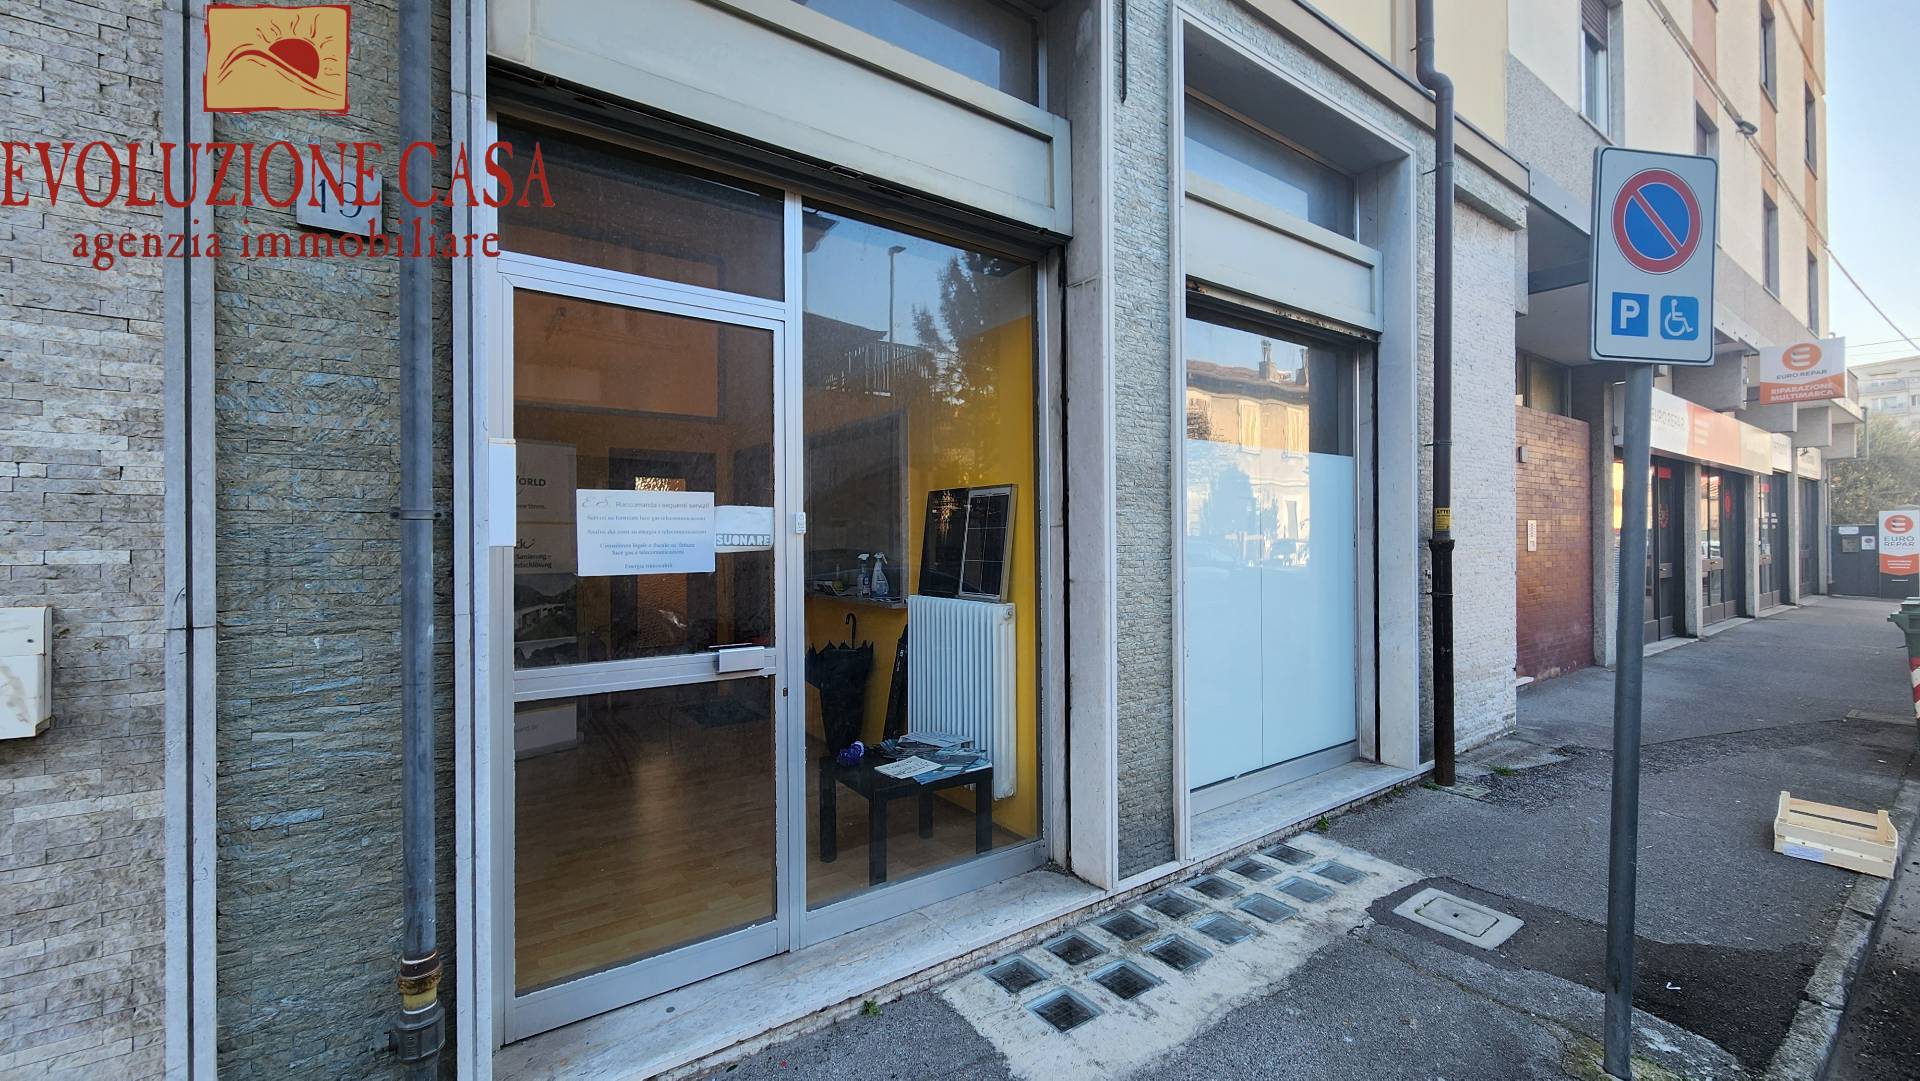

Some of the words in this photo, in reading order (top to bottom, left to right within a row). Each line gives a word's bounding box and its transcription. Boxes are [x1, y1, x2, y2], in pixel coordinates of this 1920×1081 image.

[1620, 299, 1641, 329] P
[1771, 383, 1834, 394] RIPARAZIONE
[1771, 390, 1834, 401] MULTIMARCA
[516, 476, 547, 487] ORLD
[716, 534, 770, 546] SUONARE
